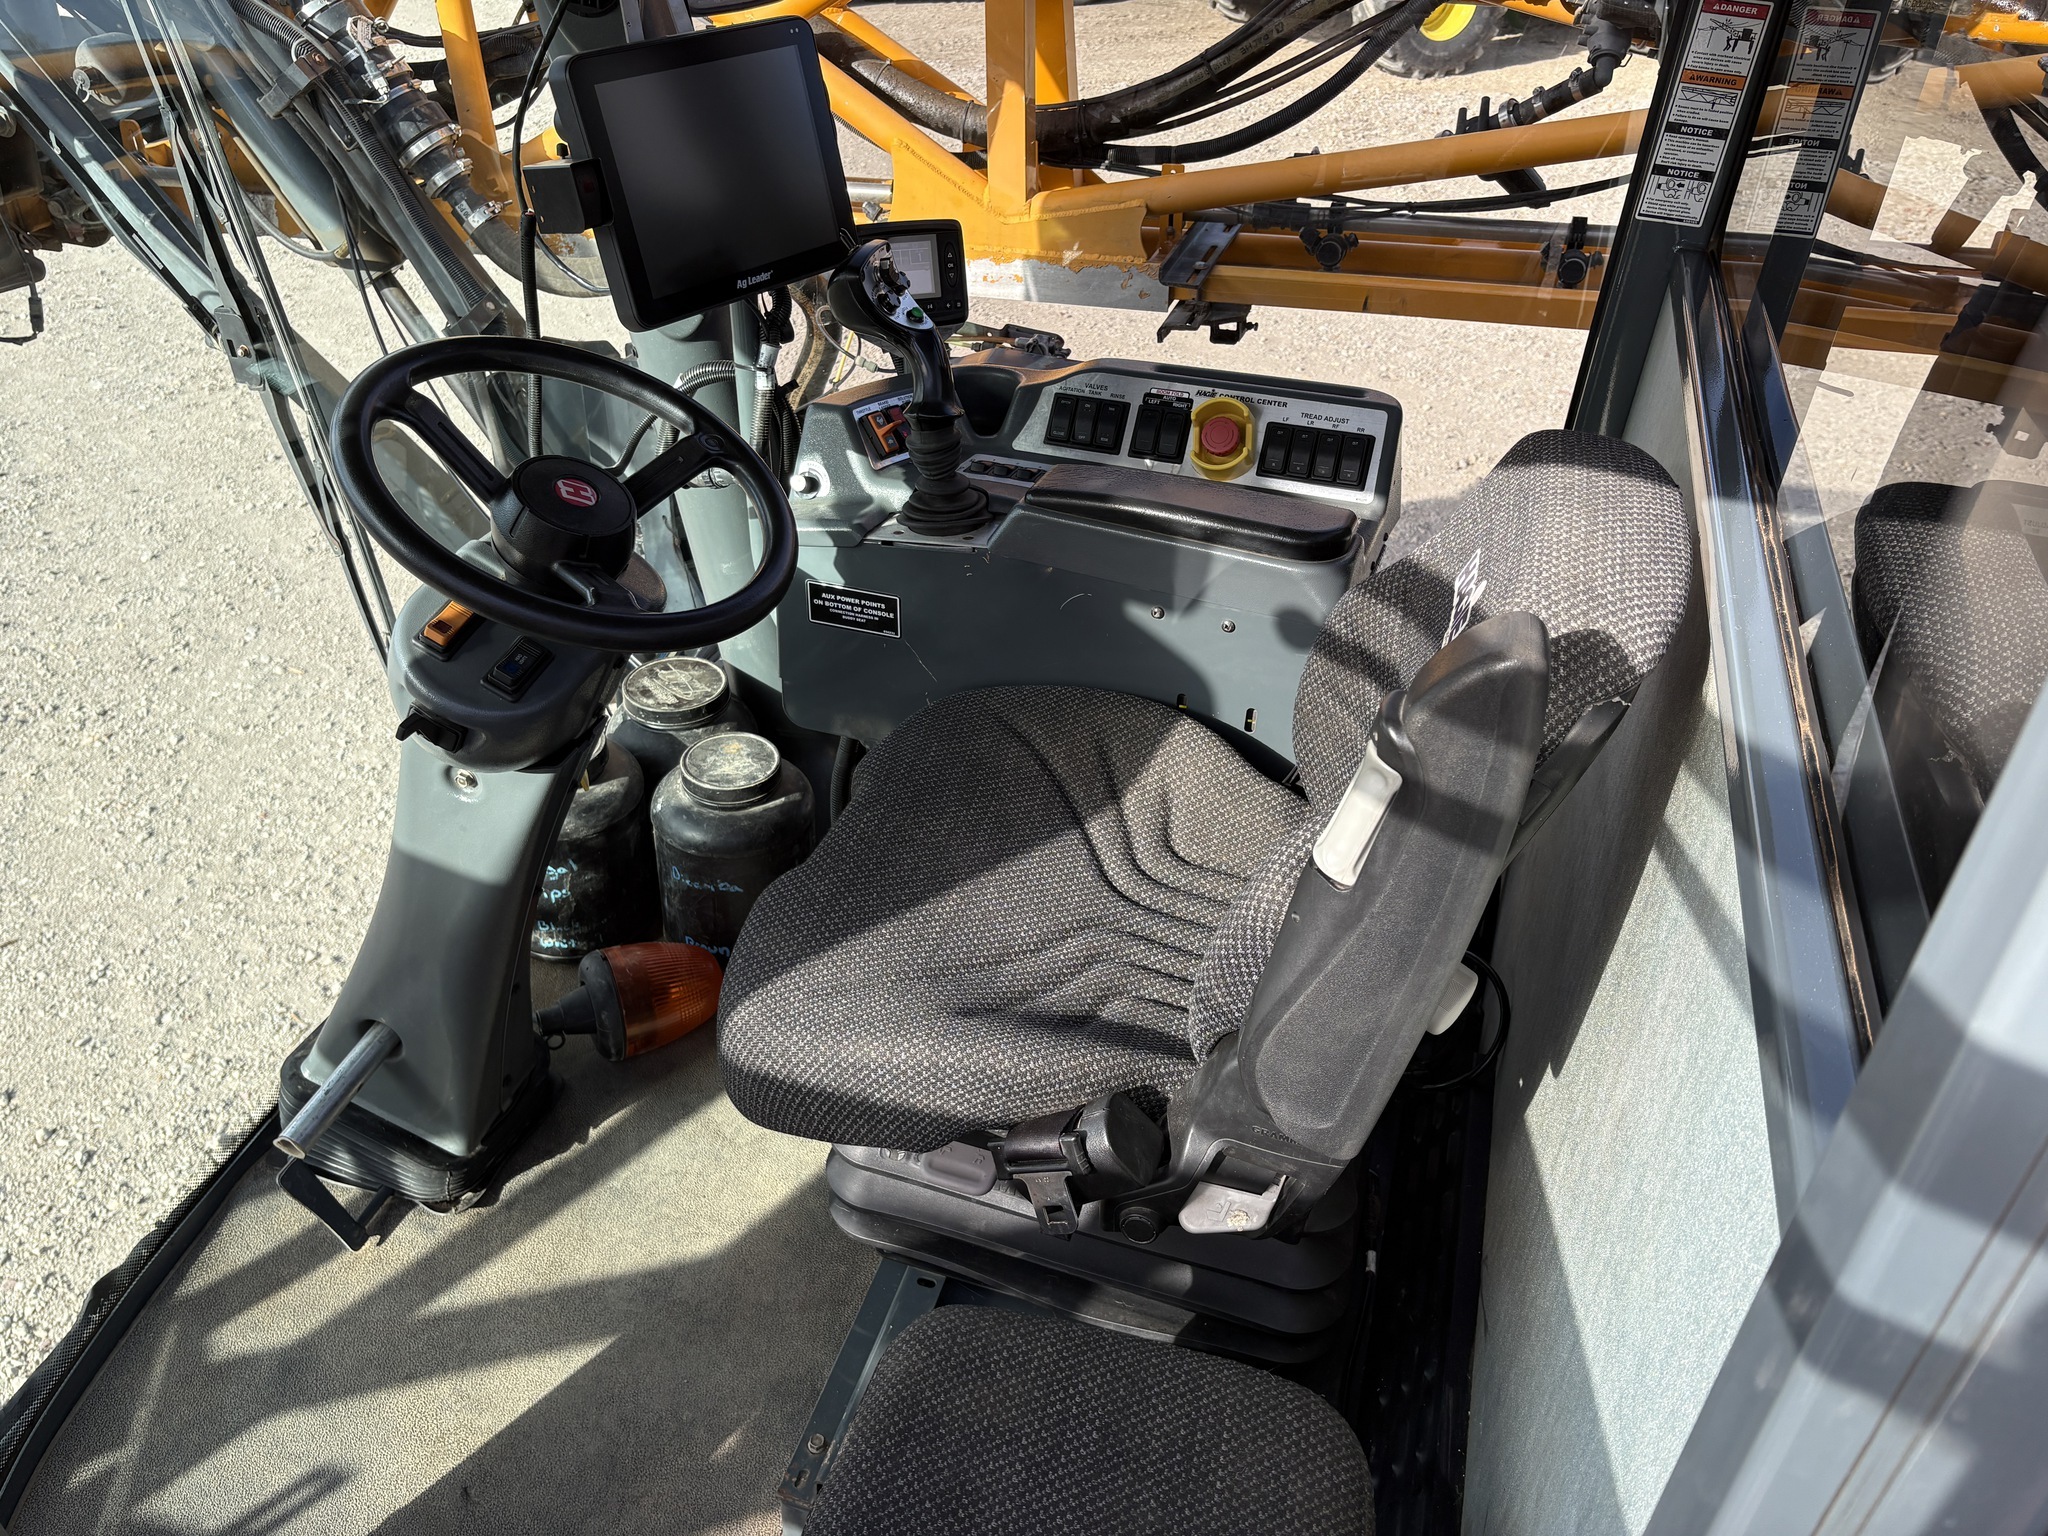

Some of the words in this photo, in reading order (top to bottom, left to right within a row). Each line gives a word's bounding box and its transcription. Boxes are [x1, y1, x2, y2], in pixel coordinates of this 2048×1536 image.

[1720, 3, 1758, 15] DANGER
[1695, 75, 1737, 86] WARNING
[1680, 126, 1714, 136] NOTICE
[1667, 168, 1700, 179] NOTICE
[736, 279, 748, 290] Ag
[747, 271, 771, 286] Leader
[1058, 386, 1086, 394] AGITATION
[1085, 382, 1108, 392] VALVES
[1088, 389, 1103, 397] TANK
[1109, 392, 1126, 400] RINSE
[1257, 398, 1288, 408] CENTER
[1300, 412, 1323, 421] TREAD
[1323, 415, 1350, 425] ADJUST
[821, 592, 836, 600] AUX
[836, 595, 860, 605] POWER
[860, 600, 886, 610] POINTS
[813, 598, 824, 606] ON
[824, 600, 852, 611] BOTTOM
[863, 608, 895, 619] CONSOLE
[829, 608, 855, 616] CONNECTION
[855, 612, 874, 620] HARNESS
